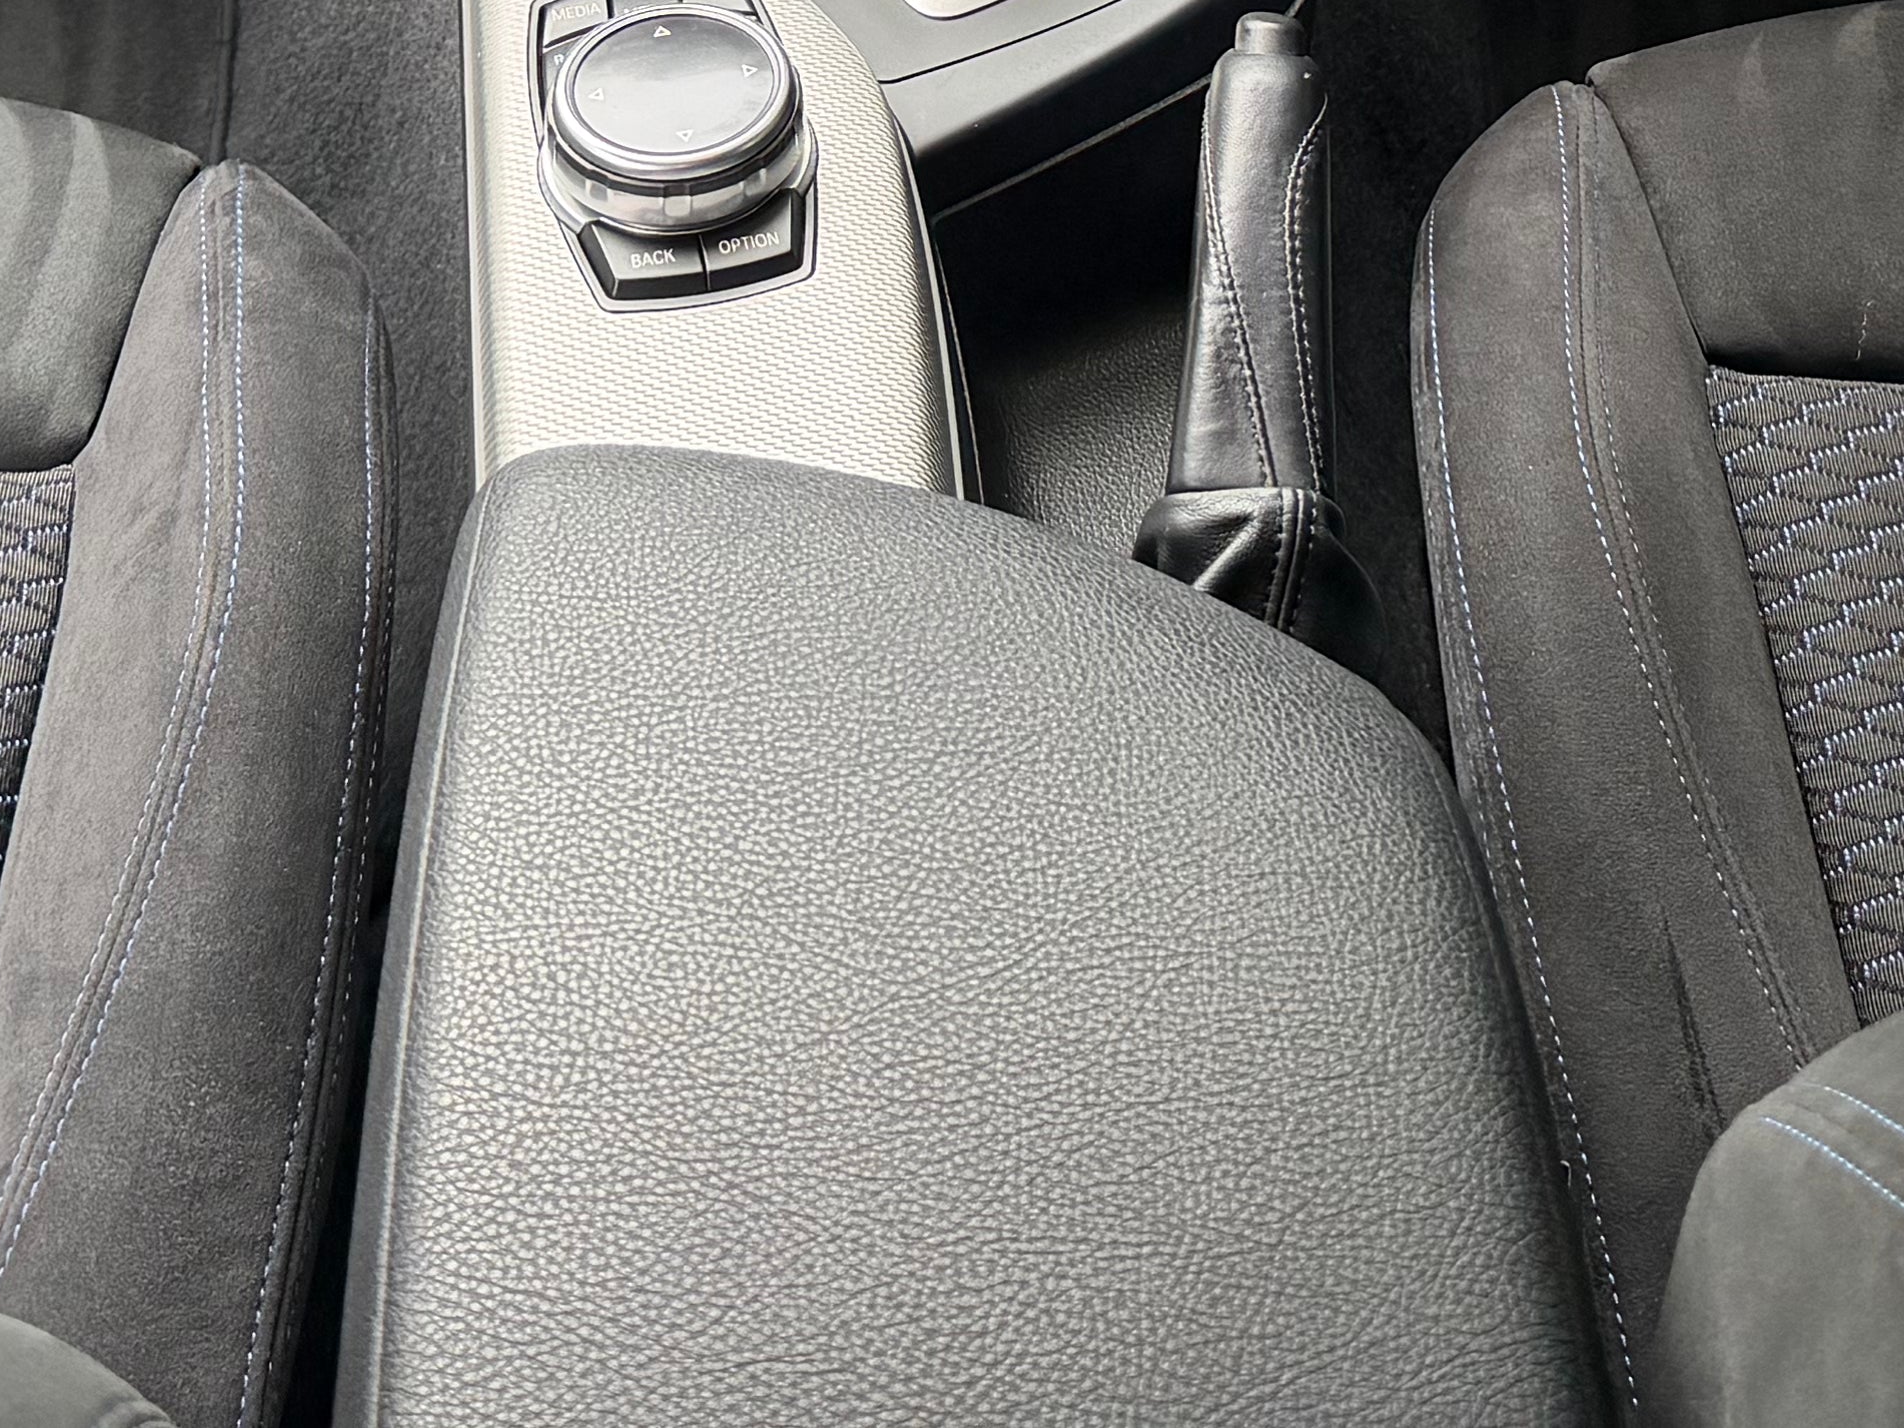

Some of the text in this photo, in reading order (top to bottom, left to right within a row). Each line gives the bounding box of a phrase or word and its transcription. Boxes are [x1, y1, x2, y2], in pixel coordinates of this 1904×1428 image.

[551, 3, 602, 22] MEDIA
[718, 231, 780, 255] OPTION
[630, 248, 677, 269] BACK
